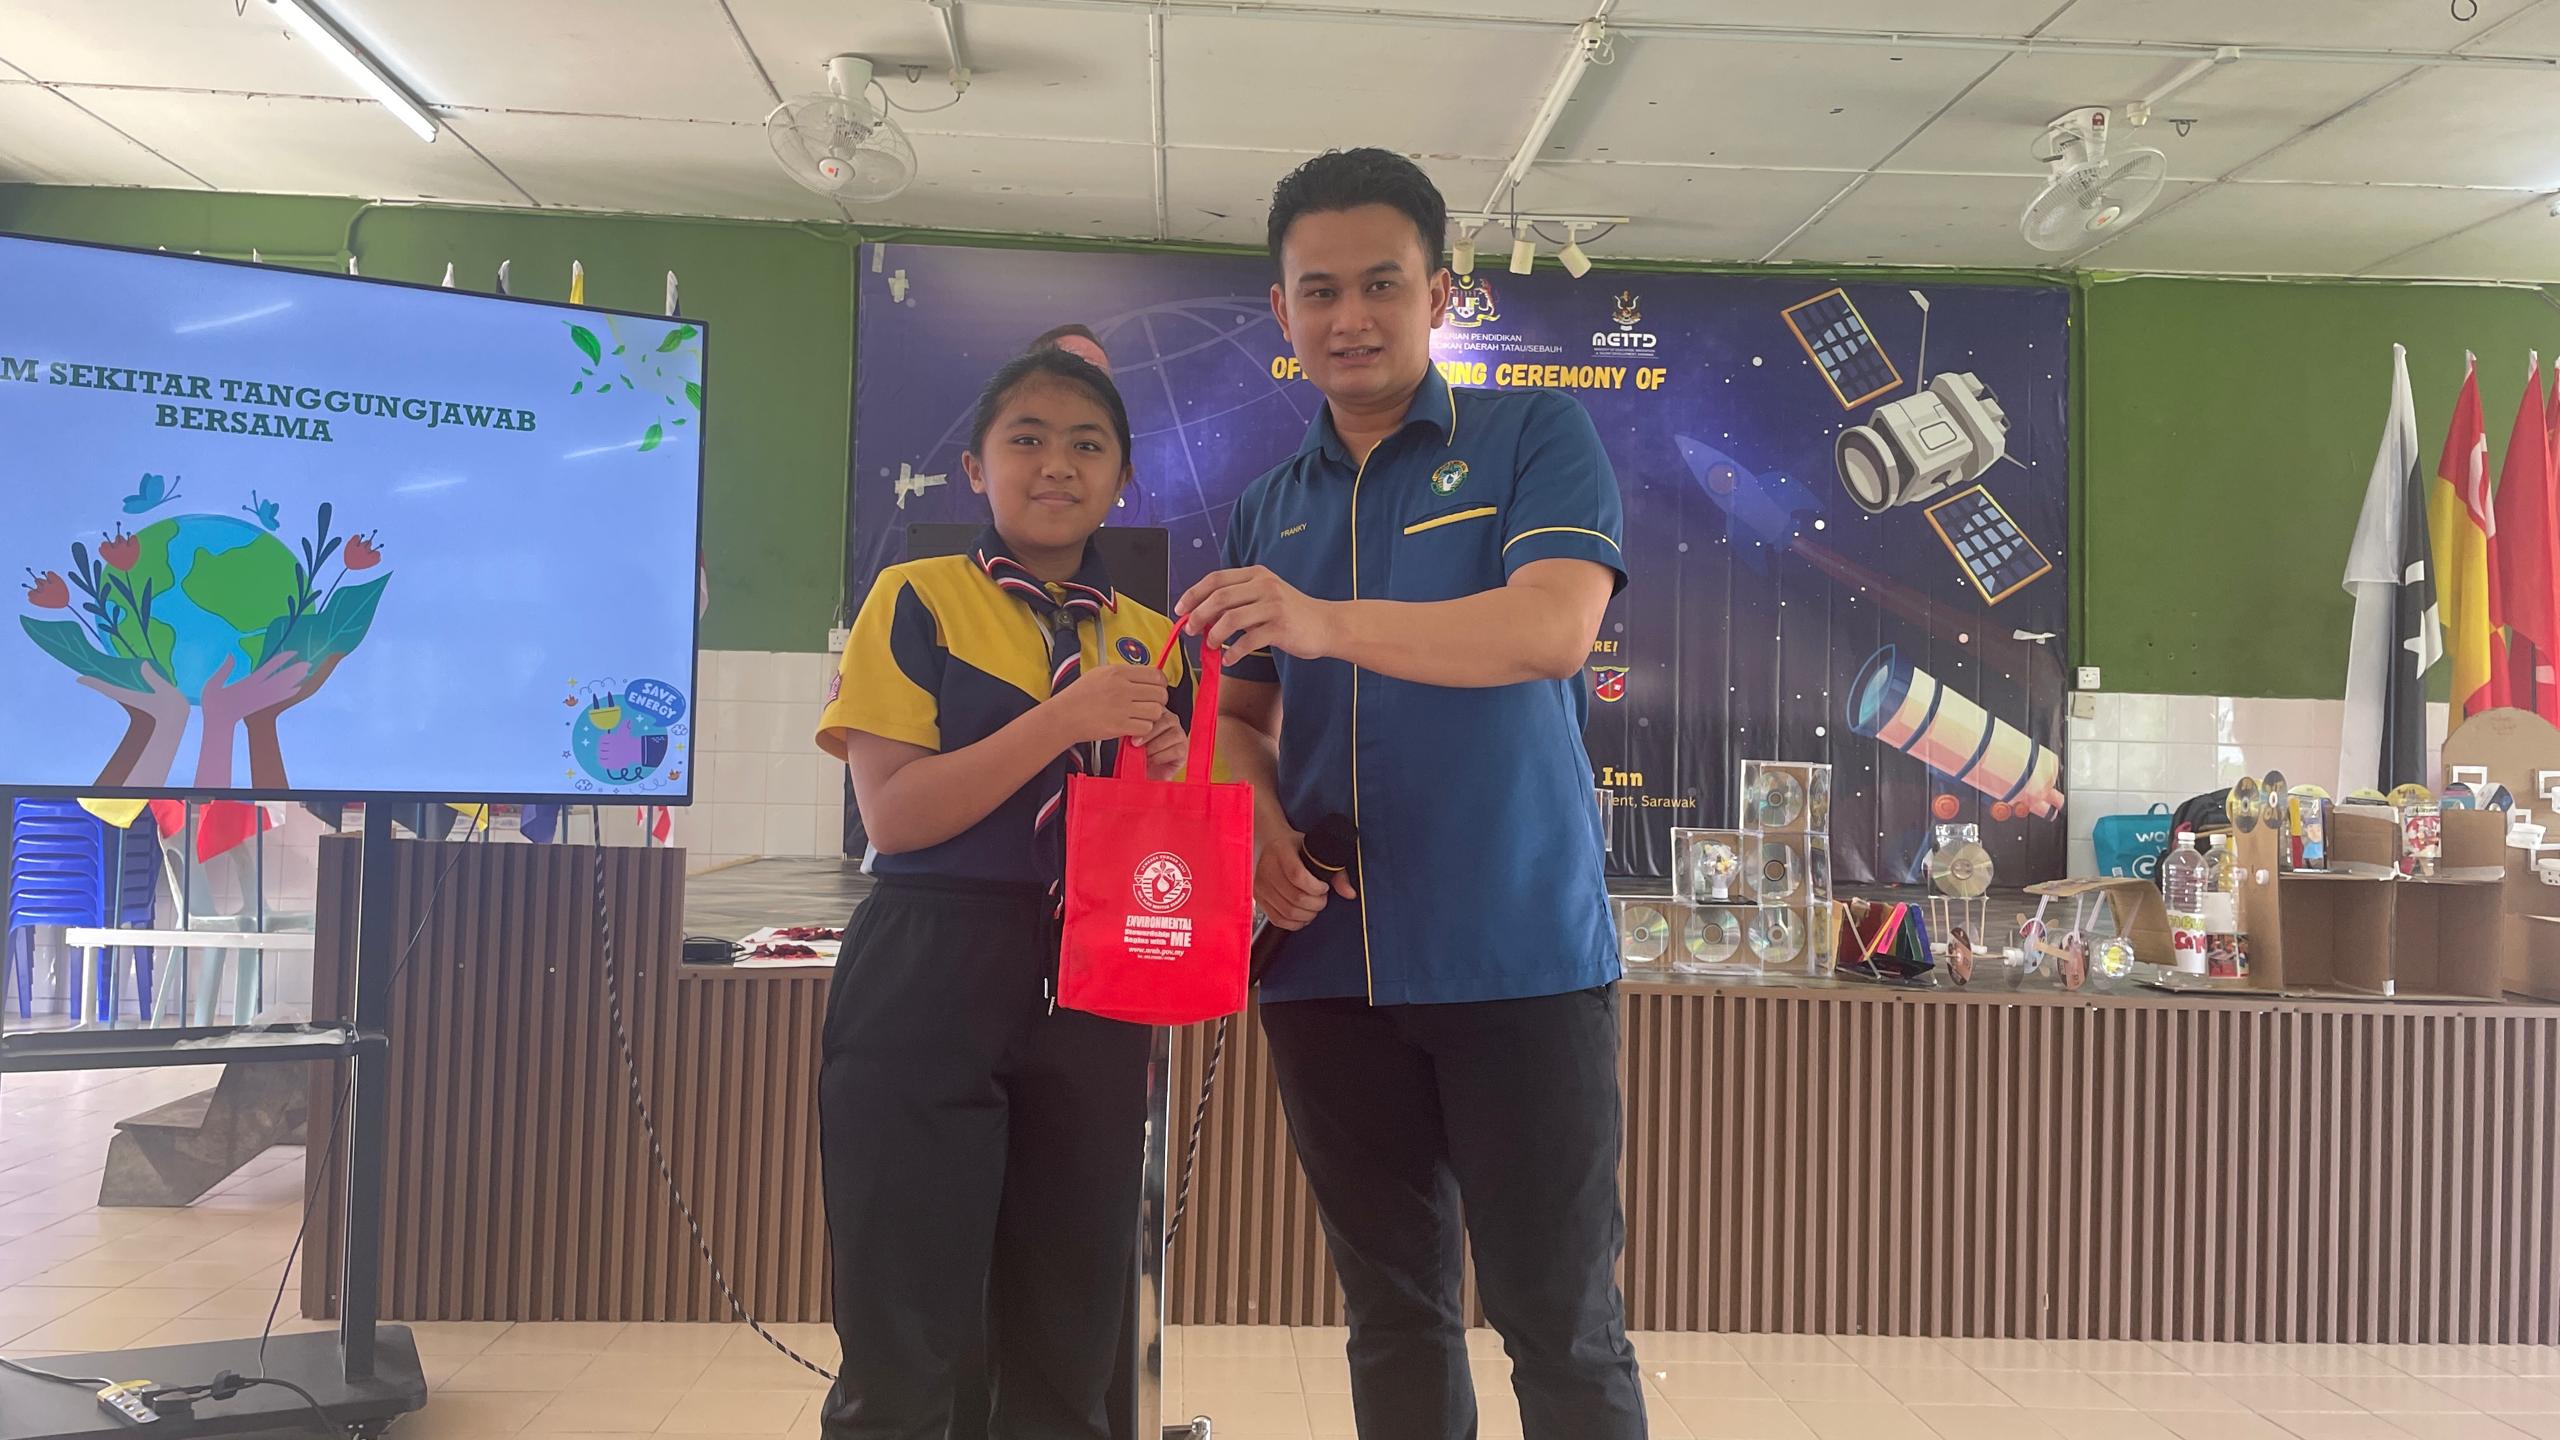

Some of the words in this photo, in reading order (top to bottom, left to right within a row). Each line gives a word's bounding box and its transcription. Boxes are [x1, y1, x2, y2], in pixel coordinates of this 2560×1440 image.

[1471, 333, 1521, 342] PENDIDIKAN
[1464, 343, 1499, 351] DAERAH
[1501, 344, 1562, 353] TATAU/SEBAUH
[1271, 356, 1309, 379] OF
[1436, 361, 1488, 385] SING
[1495, 363, 1627, 390] CEREMONY
[1635, 366, 1667, 390] OF
[50, 362, 213, 400] SEKITAR
[220, 379, 536, 432] TANGGUNGJAWAB
[155, 403, 333, 442] BERSAMA
[1280, 522, 1308, 539] FRANKY
[1594, 640, 1618, 657] RE!
[642, 682, 677, 706] SAVE
[627, 691, 677, 719] ENERGY
[1602, 767, 1643, 786] Inn
[1611, 796, 1637, 808] ent,
[1641, 795, 1697, 808] Sarawak
[1126, 915, 1192, 930] ENVIRONMENTAL
[1170, 931, 1192, 947] ME
